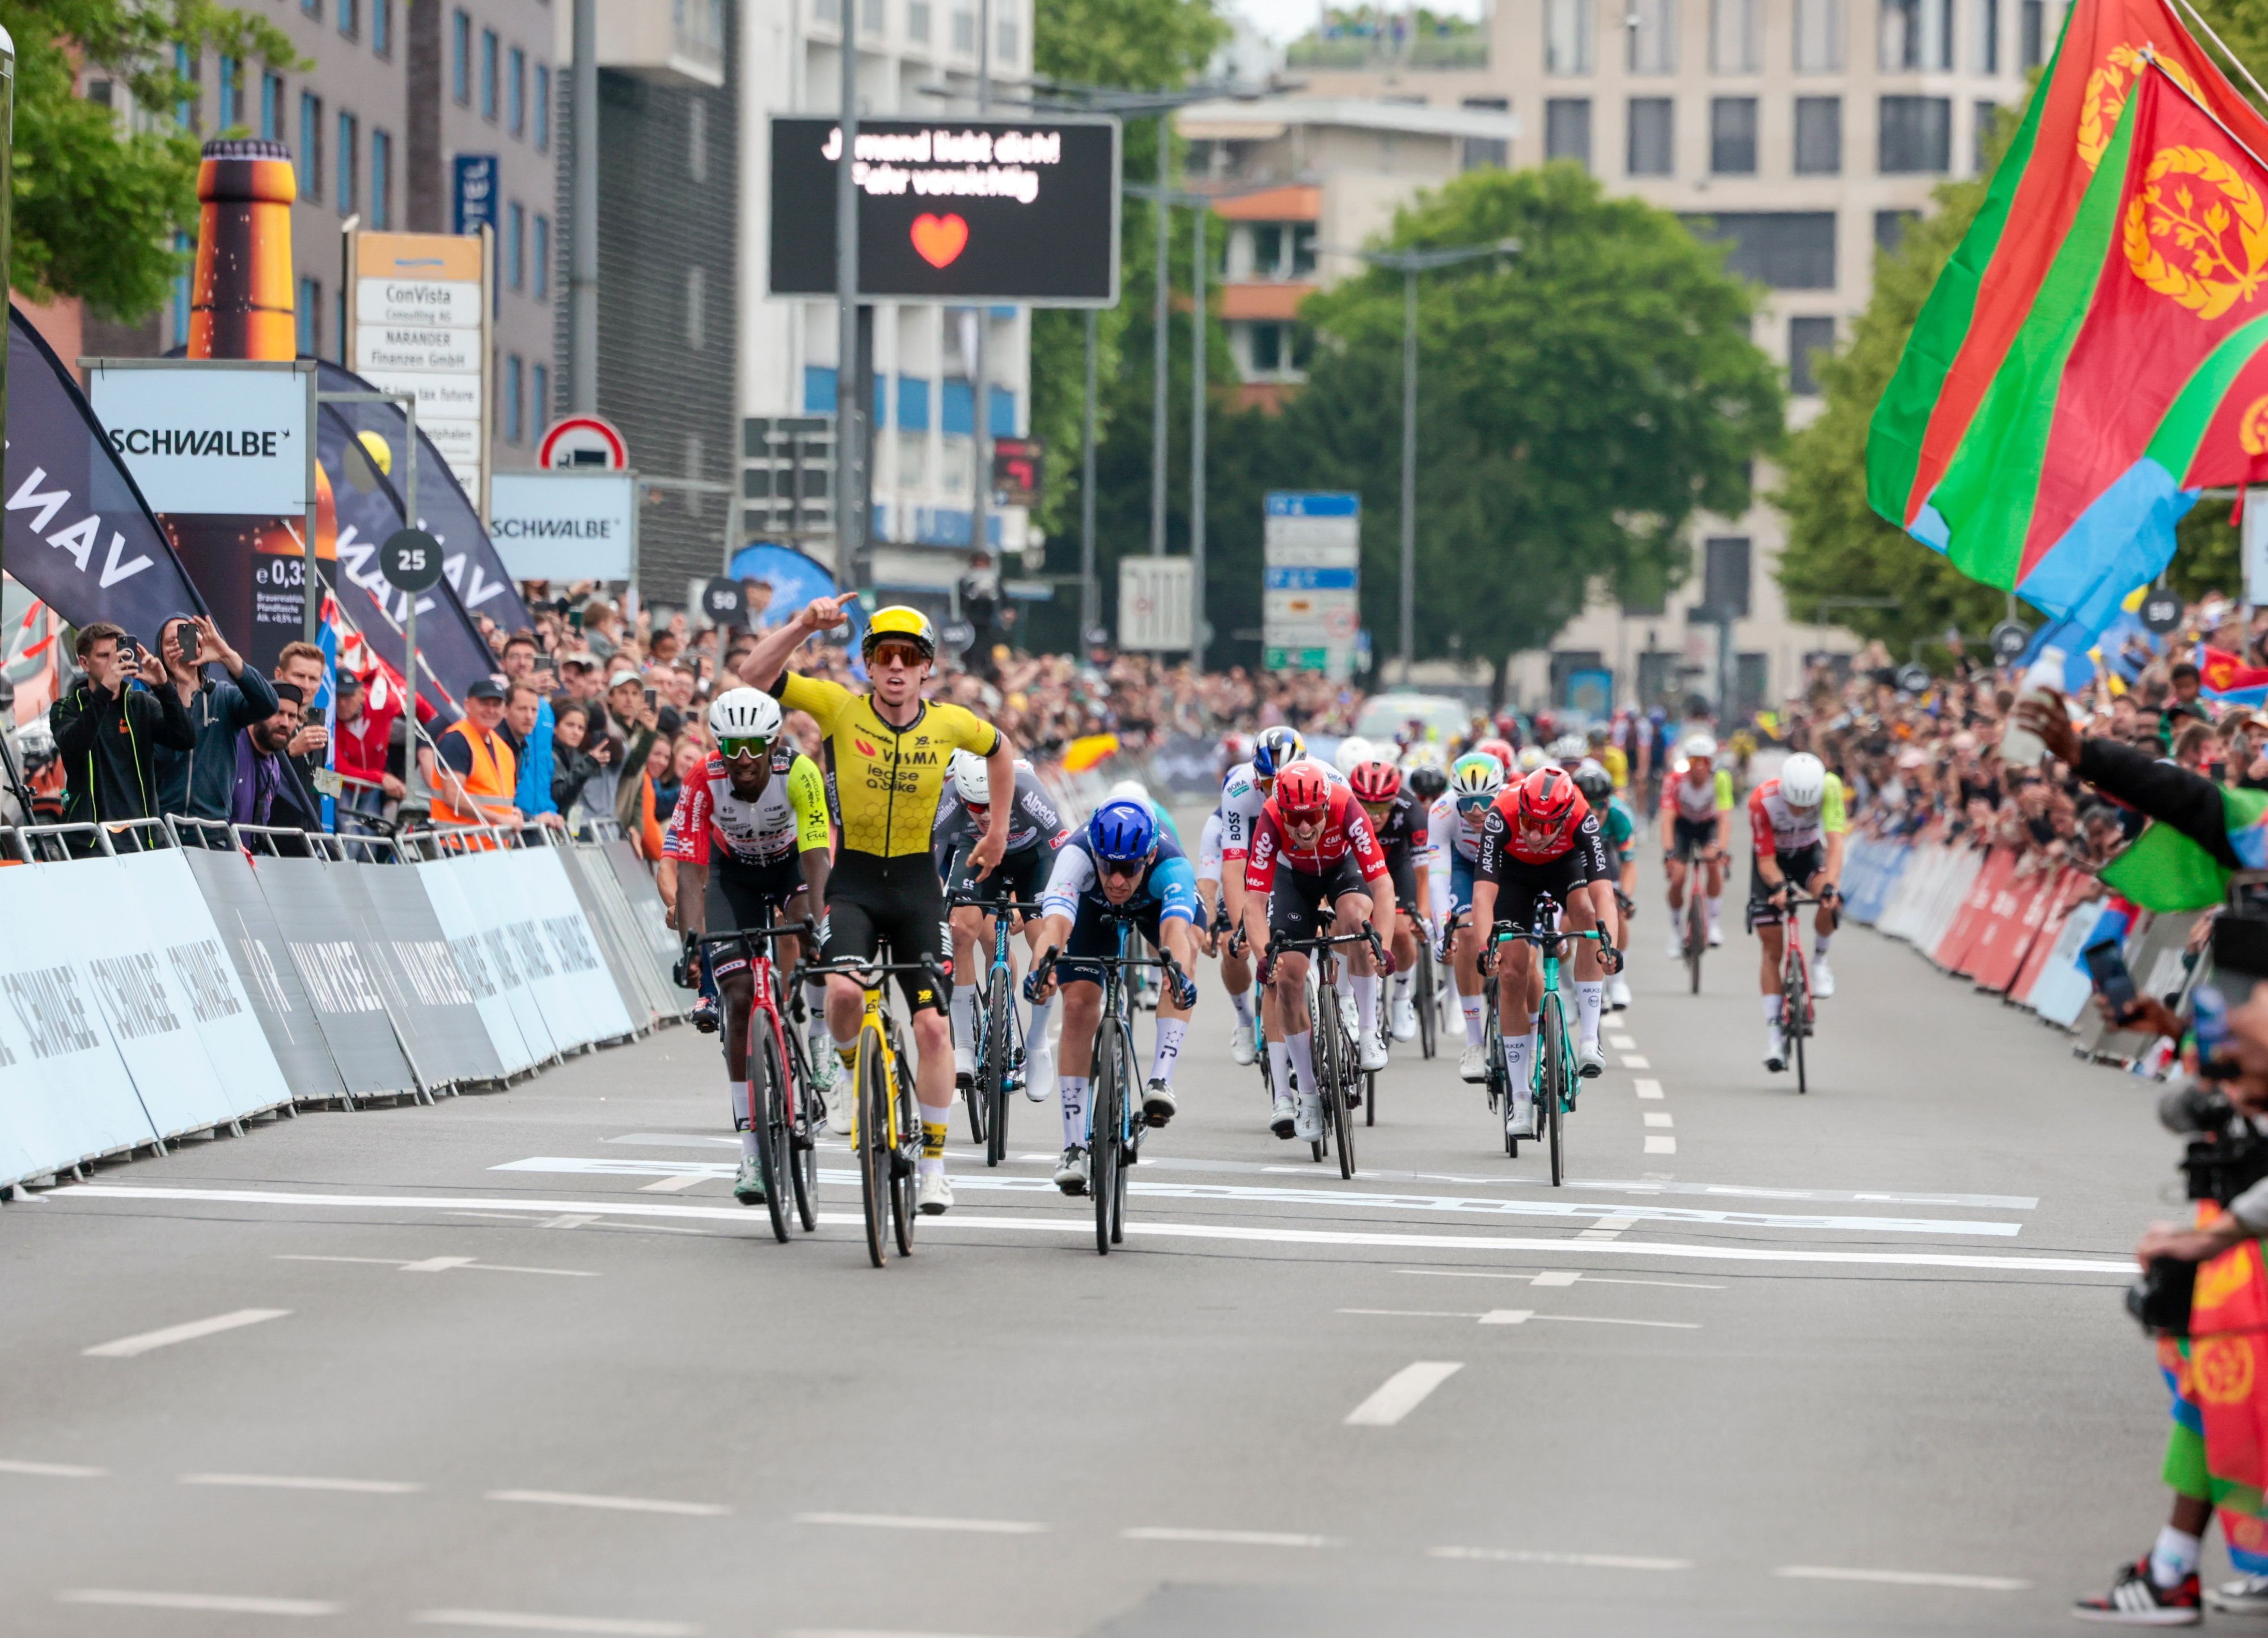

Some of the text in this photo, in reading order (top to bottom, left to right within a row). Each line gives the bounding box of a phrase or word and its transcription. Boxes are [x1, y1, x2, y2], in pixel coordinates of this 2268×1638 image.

[821, 127, 932, 161] Jmand
[386, 285, 451, 304] ConVista
[109, 429, 277, 457] SCHWALBE
[492, 518, 611, 539] SCHWALBE
[398, 549, 426, 570] 25
[712, 593, 737, 610] 50
[2148, 602, 2176, 621] 50
[883, 748, 938, 765] VISMA
[1227, 779, 1247, 793] BORA
[1022, 791, 1058, 828] Alpecin
[1228, 811, 1241, 841] BOSS
[1348, 816, 1373, 856] Lotto
[1053, 832, 1071, 846] Alpe
[1250, 832, 1273, 870] Lotto
[1483, 835, 1495, 873] ARKEA
[1590, 836, 1607, 872] ARKEA
[1246, 876, 1264, 887] otto
